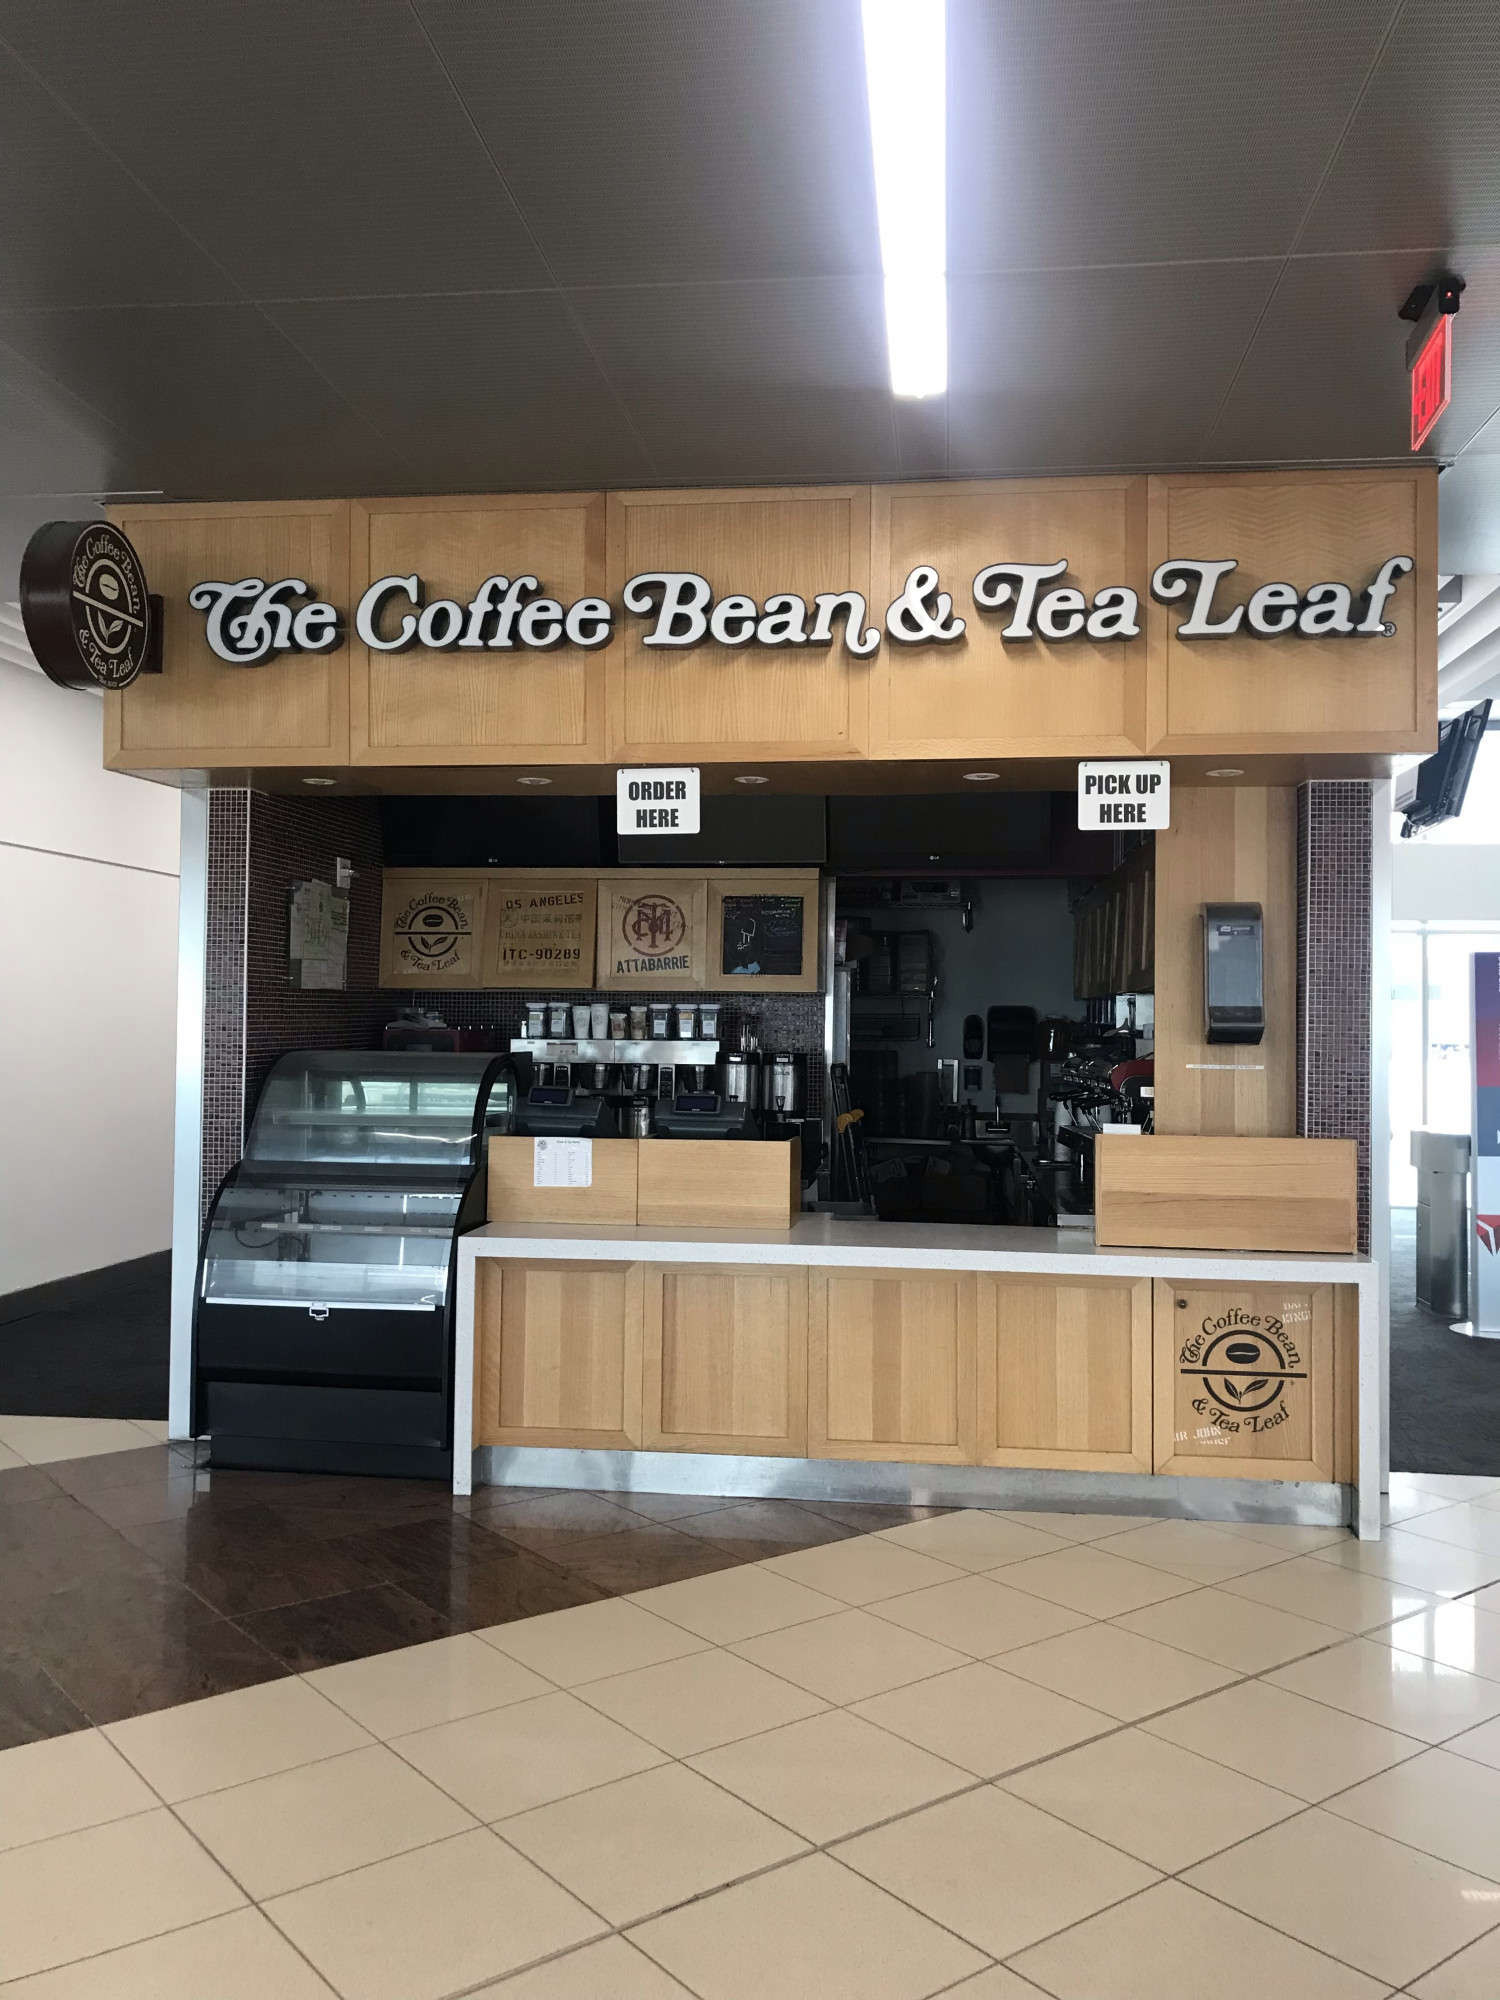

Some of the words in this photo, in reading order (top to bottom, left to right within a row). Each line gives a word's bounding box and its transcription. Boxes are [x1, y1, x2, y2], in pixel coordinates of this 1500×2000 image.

[73, 555, 89, 587] The
[86, 534, 120, 560] Coffee
[121, 551, 140, 614] Bean
[189, 577, 340, 664] The
[356, 574, 612, 651] Coffee
[623, 571, 880, 660] Bean
[885, 565, 966, 645] &
[973, 558, 1141, 643] Tea
[79, 629, 90, 649] &
[89, 642, 107, 675] Tea
[108, 646, 133, 678] Leaf
[628, 781, 686, 801] ORDER
[1085, 774, 1131, 794] PICK
[1136, 774, 1162, 794] UP
[636, 808, 679, 828] HERE
[1099, 803, 1146, 823] HERE
[394, 911, 411, 929] The
[409, 892, 446, 911] Coffee
[446, 896, 469, 930] Bean
[529, 893, 584, 909] ANGELES
[411, 956, 431, 971] Tea
[432, 949, 460, 971] Leaf
[503, 948, 581, 961] ITC-90289
[616, 955, 689, 974] ATTABARRIE
[1179, 1334, 1206, 1364] The
[1201, 1308, 1262, 1336] Coffee
[1264, 1315, 1301, 1369] Bean
[1191, 1398, 1209, 1415] &
[1209, 1407, 1241, 1433] Tea
[1243, 1400, 1290, 1433] Leaf
[1193, 1426, 1222, 1439] JOHN
